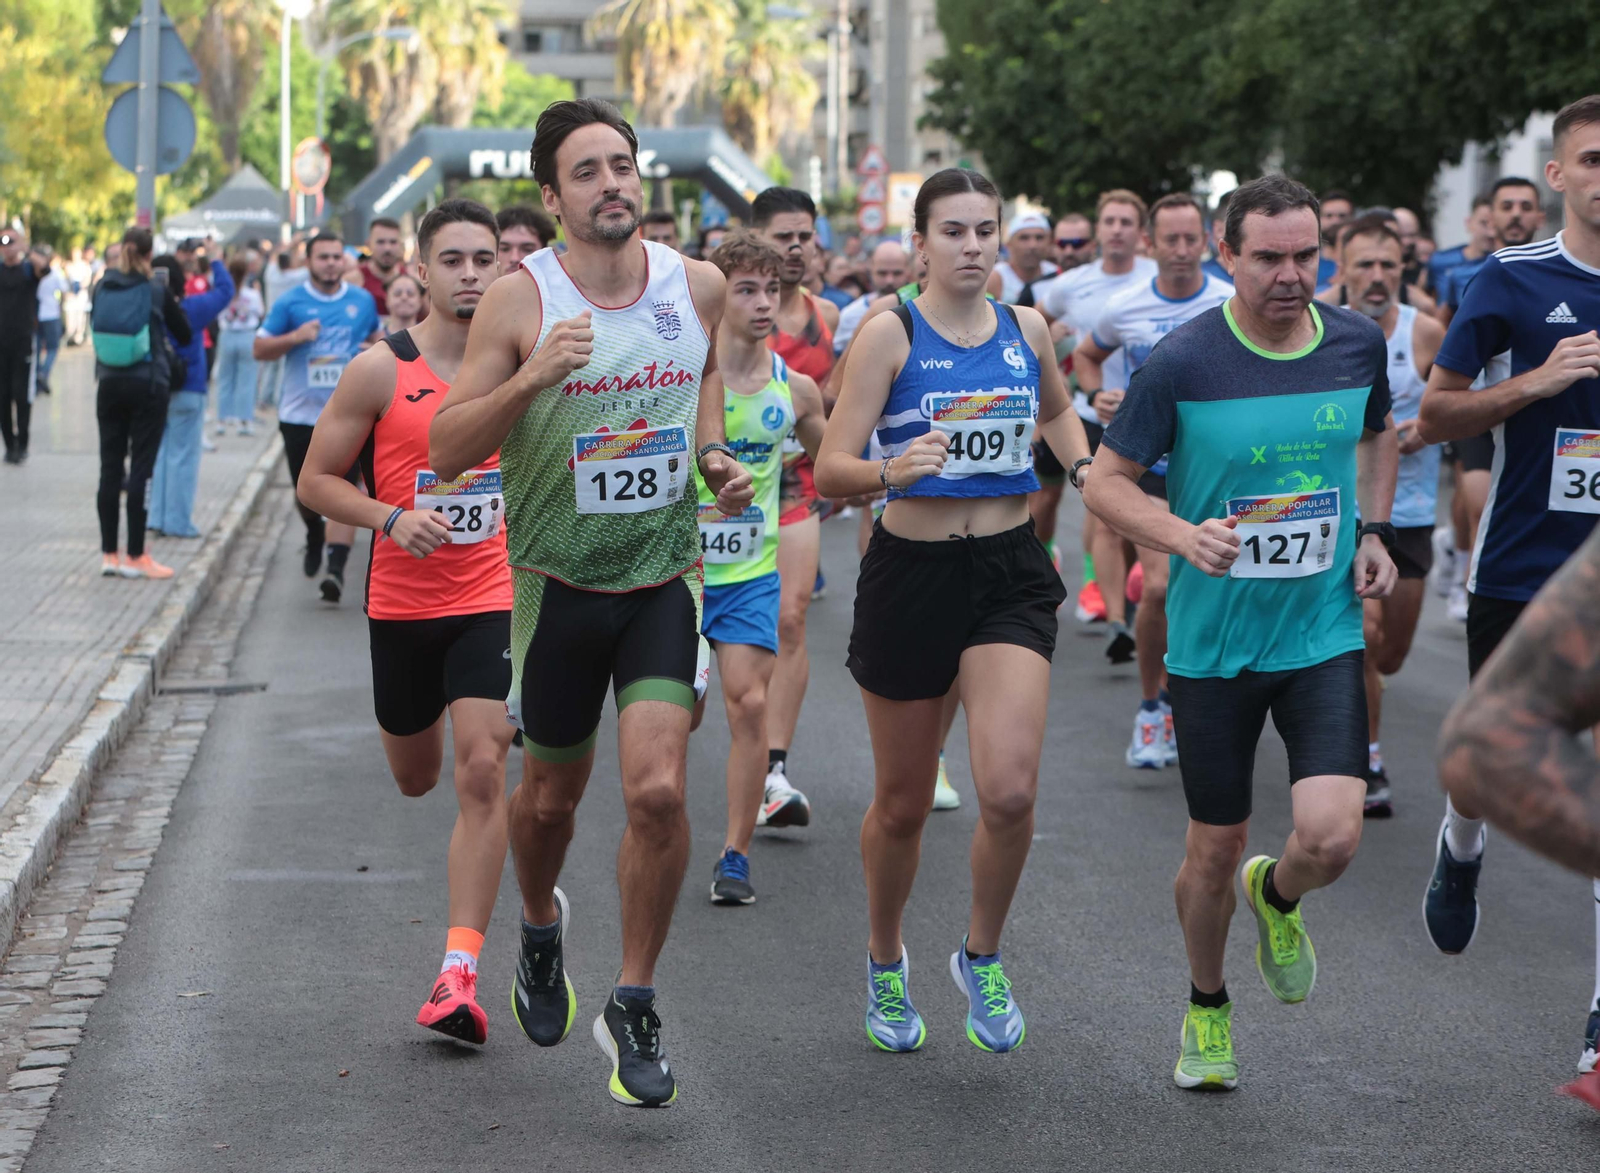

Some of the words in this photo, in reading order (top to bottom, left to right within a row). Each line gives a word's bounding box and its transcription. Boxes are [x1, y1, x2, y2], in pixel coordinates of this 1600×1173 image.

[1545, 315, 1578, 324] adidas
[920, 357, 954, 369] vive
[562, 360, 694, 397] maratón
[600, 397, 660, 413] JEREZ
[940, 400, 984, 411] CARRERA
[986, 399, 1026, 409] POPULAR
[584, 437, 632, 450] CARRERA
[635, 433, 679, 446] POPULAR
[634, 446, 659, 455] SANTO
[660, 443, 684, 452] ANGEL
[946, 430, 1005, 461] 409
[1564, 437, 1600, 447] CARRE
[1250, 445, 1267, 465] X
[424, 478, 466, 486] CARRA
[468, 476, 497, 485] POPULAR
[590, 468, 658, 501] 128
[1237, 503, 1286, 512] CARRERA
[1288, 497, 1331, 510] POPULAR
[1287, 510, 1312, 519] SANTO
[1313, 507, 1336, 516] ANGEL
[1244, 531, 1311, 565] 127
